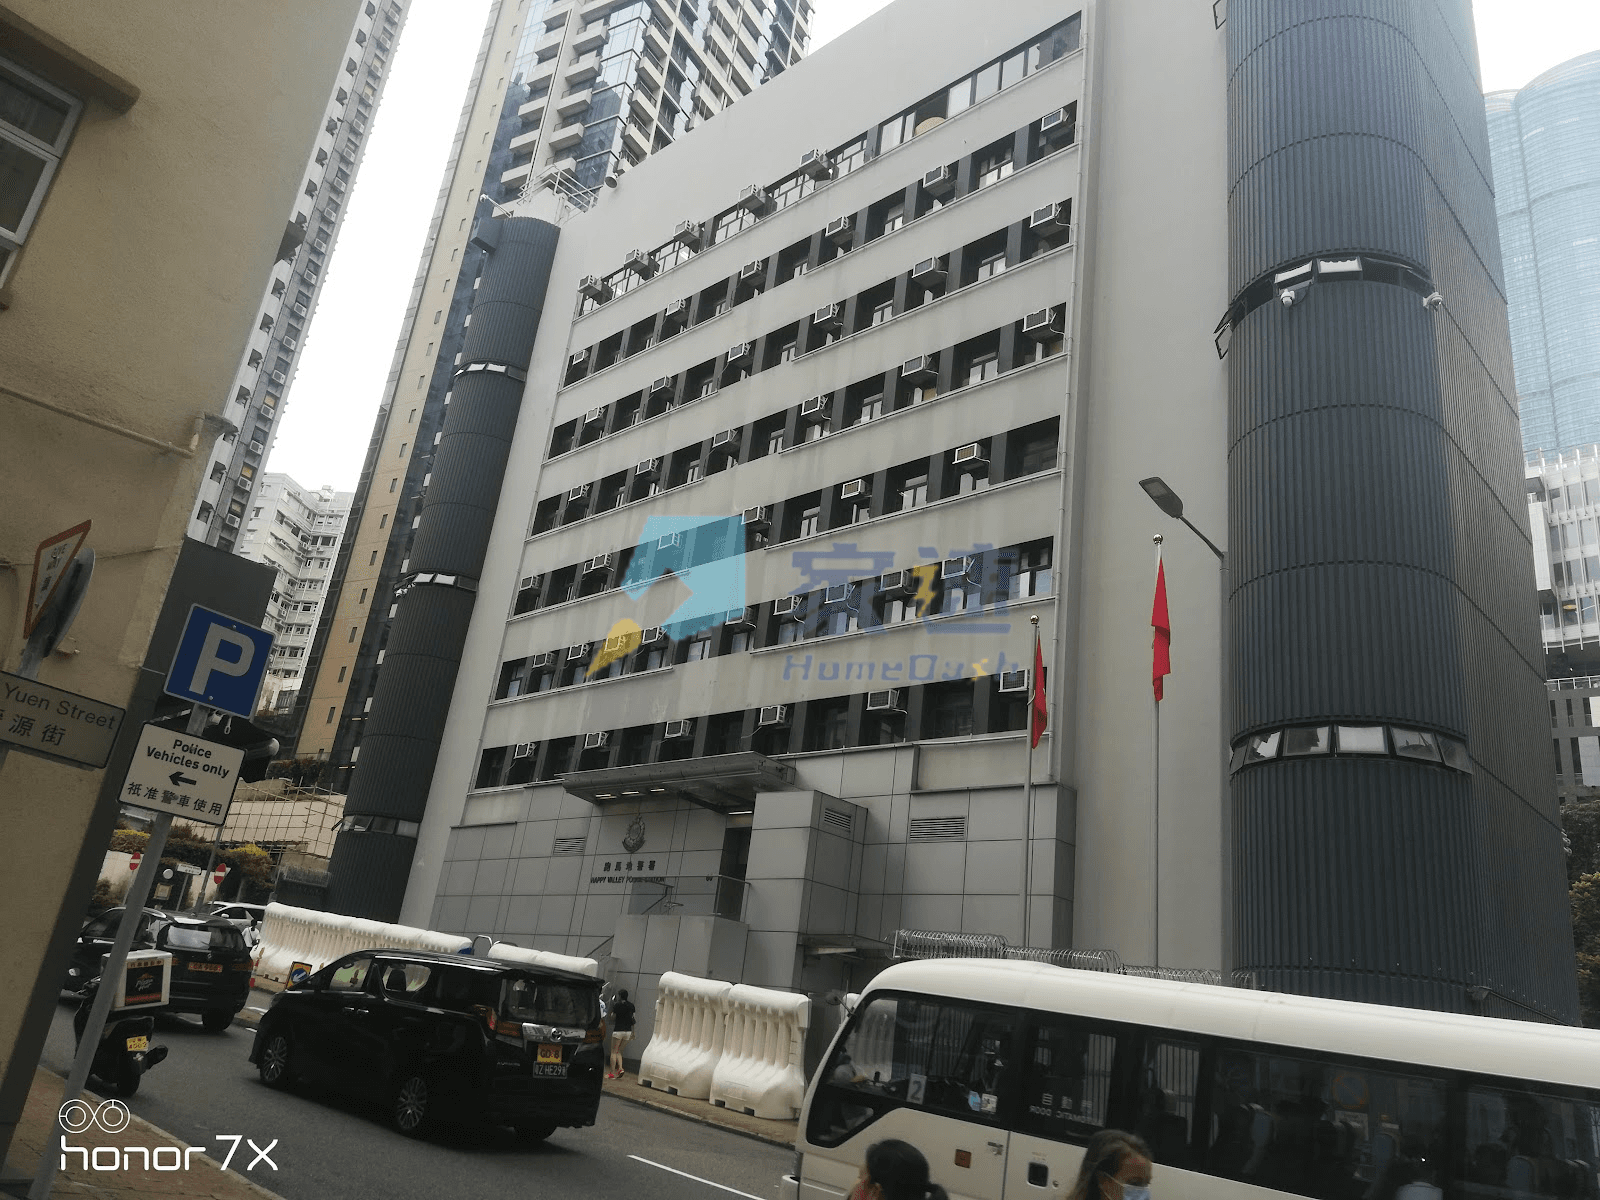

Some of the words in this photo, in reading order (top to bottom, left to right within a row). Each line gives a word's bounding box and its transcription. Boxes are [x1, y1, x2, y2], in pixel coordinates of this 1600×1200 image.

[189, 622, 255, 695] P
[5, 682, 50, 710] Yuen
[56, 700, 116, 730] Street
[146, 745, 200, 770] Vehicles
[202, 763, 230, 779] only
[172, 739, 212, 758] Police
